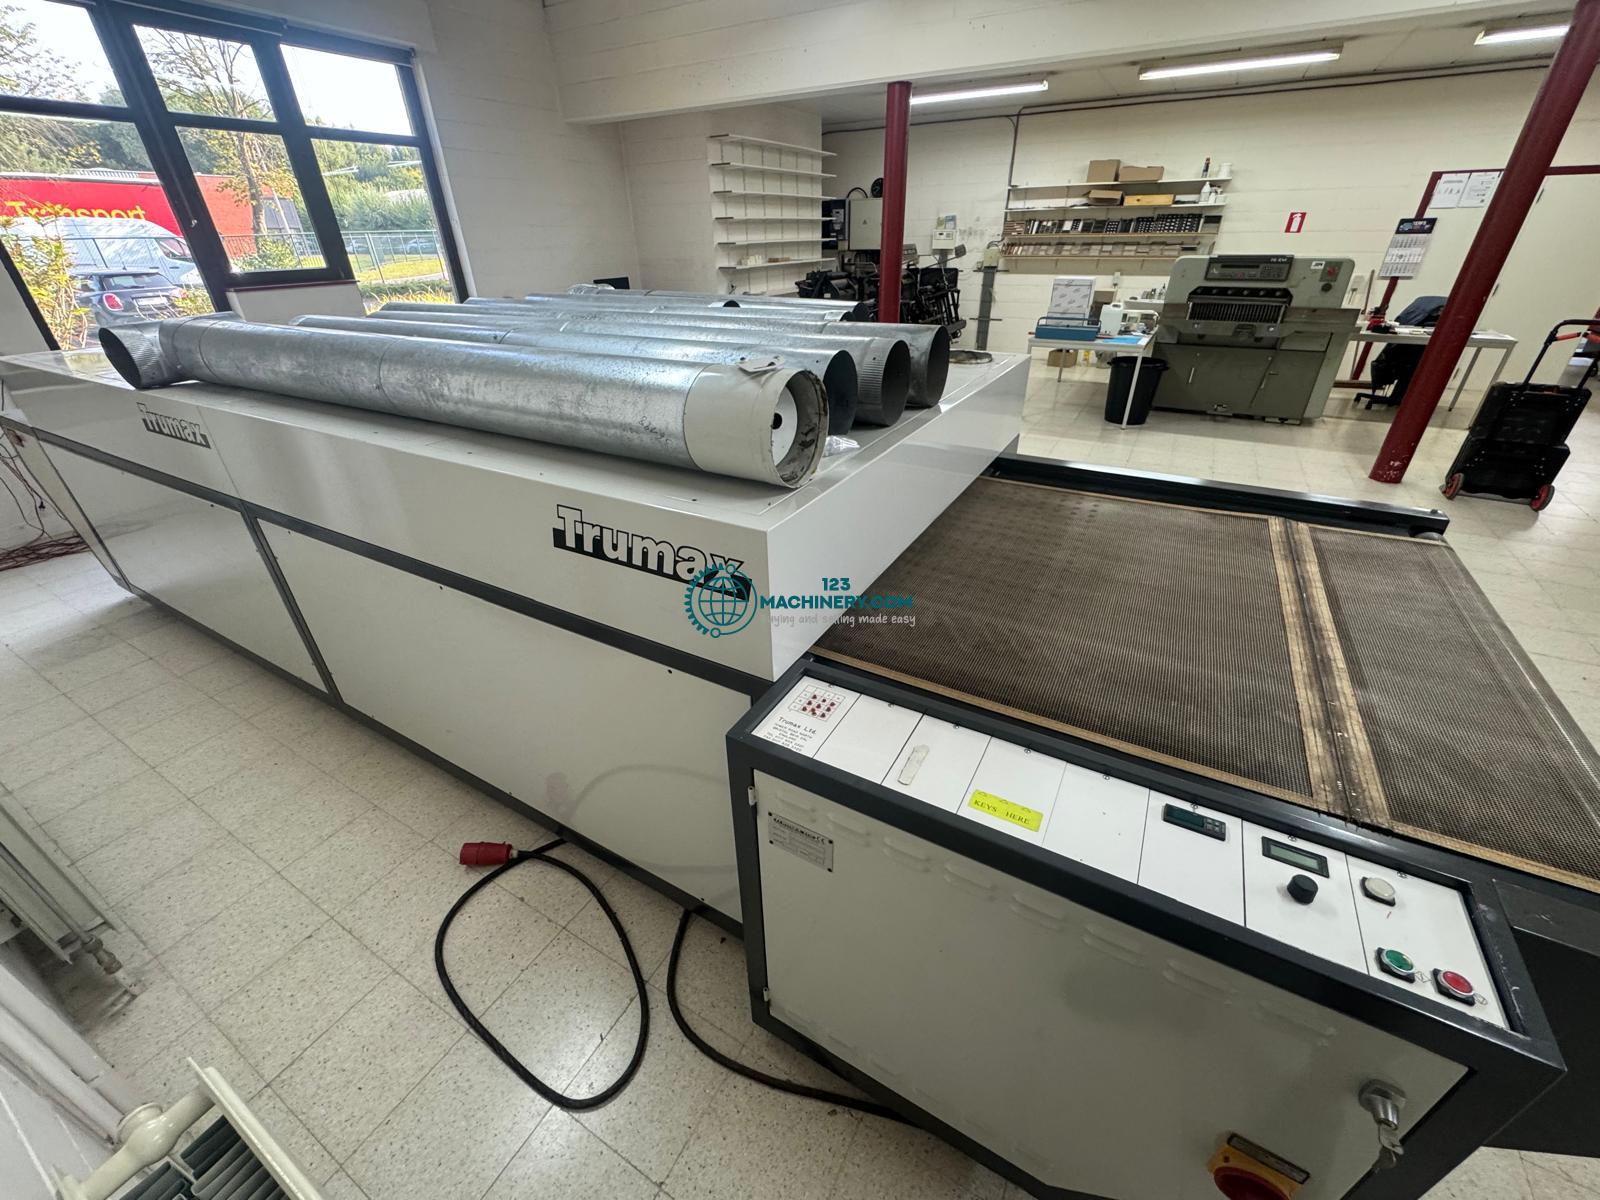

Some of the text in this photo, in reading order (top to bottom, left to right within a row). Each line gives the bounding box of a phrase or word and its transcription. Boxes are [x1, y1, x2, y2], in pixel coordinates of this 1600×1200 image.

[136, 401, 209, 447] Trumax
[555, 504, 748, 597] Trumax
[974, 799, 1030, 825] KEYS HERE
